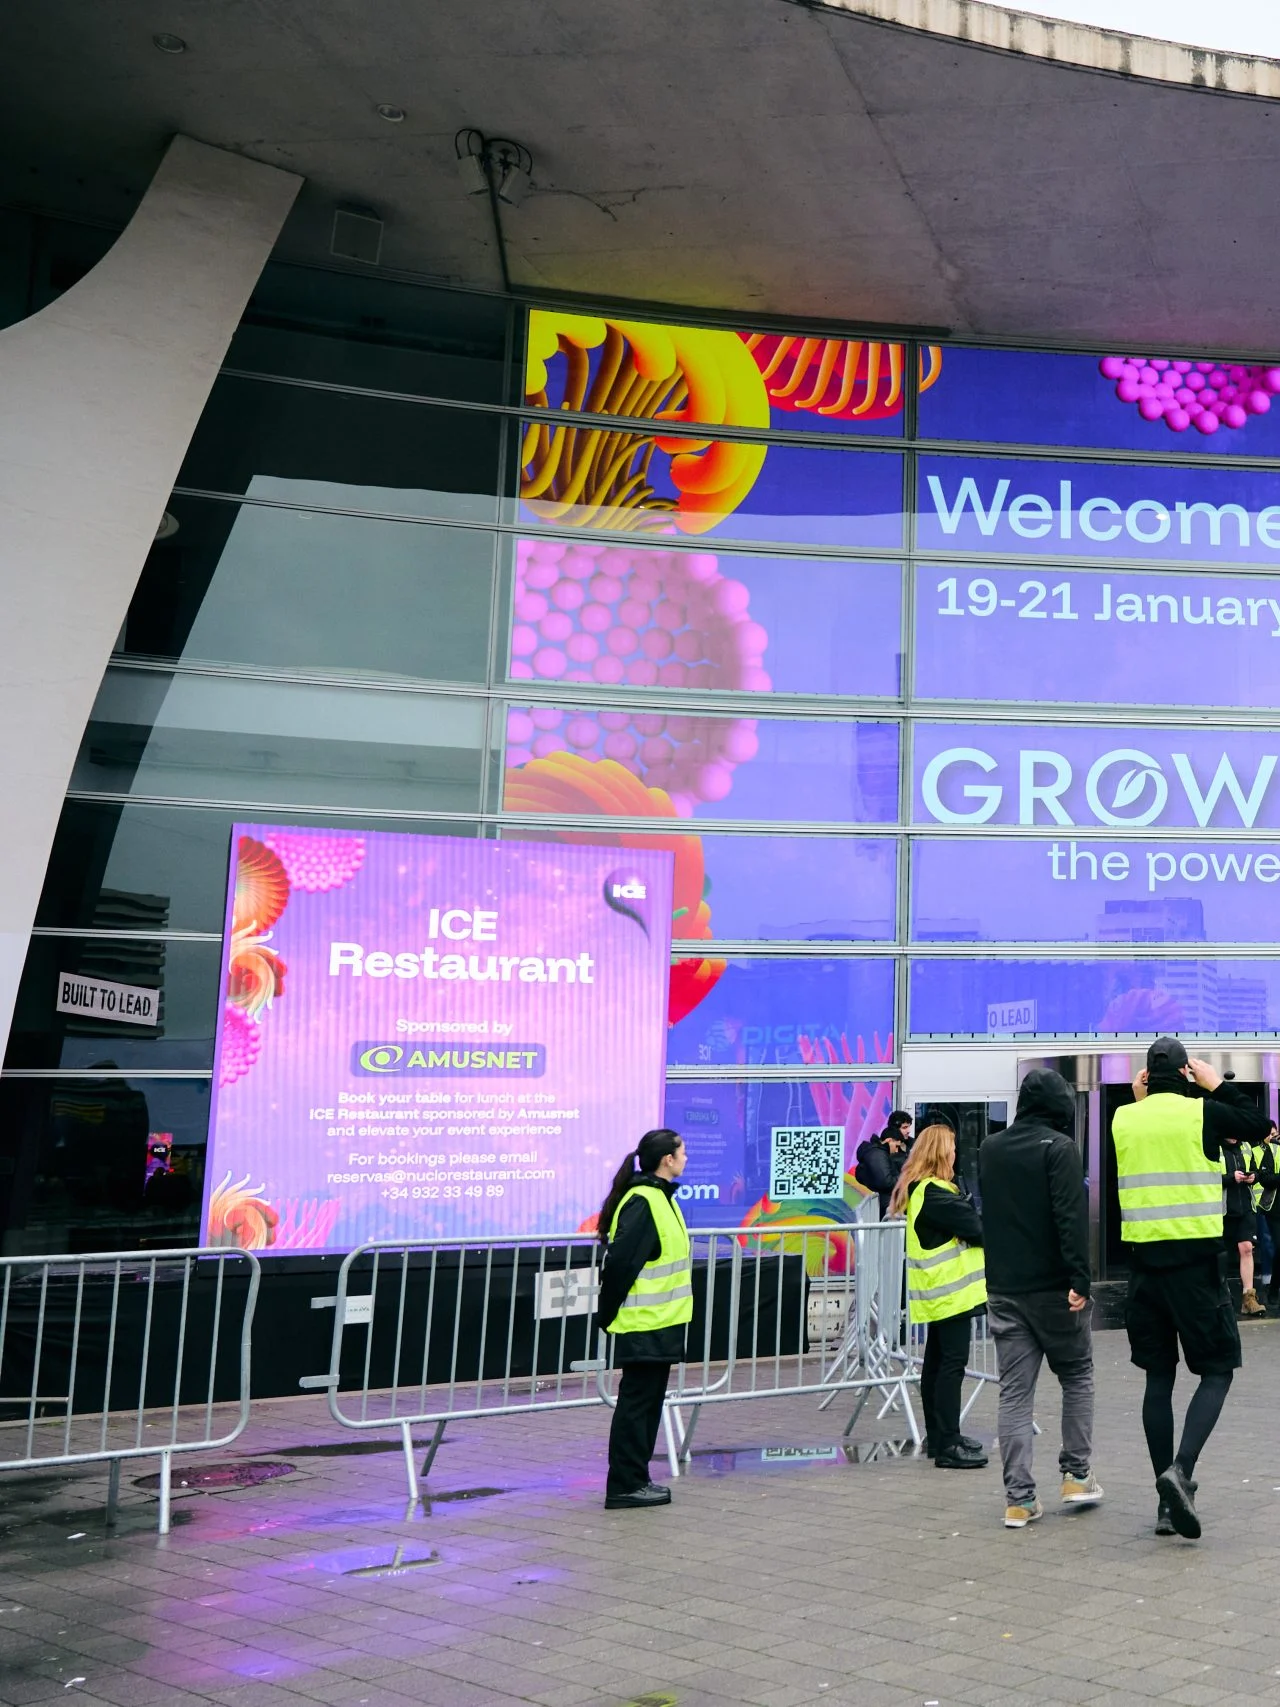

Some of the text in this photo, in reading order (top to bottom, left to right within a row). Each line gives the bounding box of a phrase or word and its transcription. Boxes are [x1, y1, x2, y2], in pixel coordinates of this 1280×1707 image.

[936, 578, 1079, 621] 19-21
[1047, 842, 1130, 882] the
[612, 885, 647, 899] ICE
[428, 908, 498, 941] ICE
[329, 942, 595, 984] Restaurant
[62, 982, 153, 1017] BUILT TO LEAD.
[396, 1019, 513, 1036] Sponsored by
[406, 1050, 538, 1069] AMUSNET
[338, 1092, 556, 1106] Book your table for lunch at the
[309, 1107, 580, 1121] ICE Restaurant sponsored by Amusnet
[327, 1123, 562, 1138] and elevate your event experience
[348, 1151, 538, 1167] For bookings please email
[327, 1168, 556, 1185] reservas@nuclorestaurant.com
[381, 1184, 505, 1200] +34 932 33 49 89
